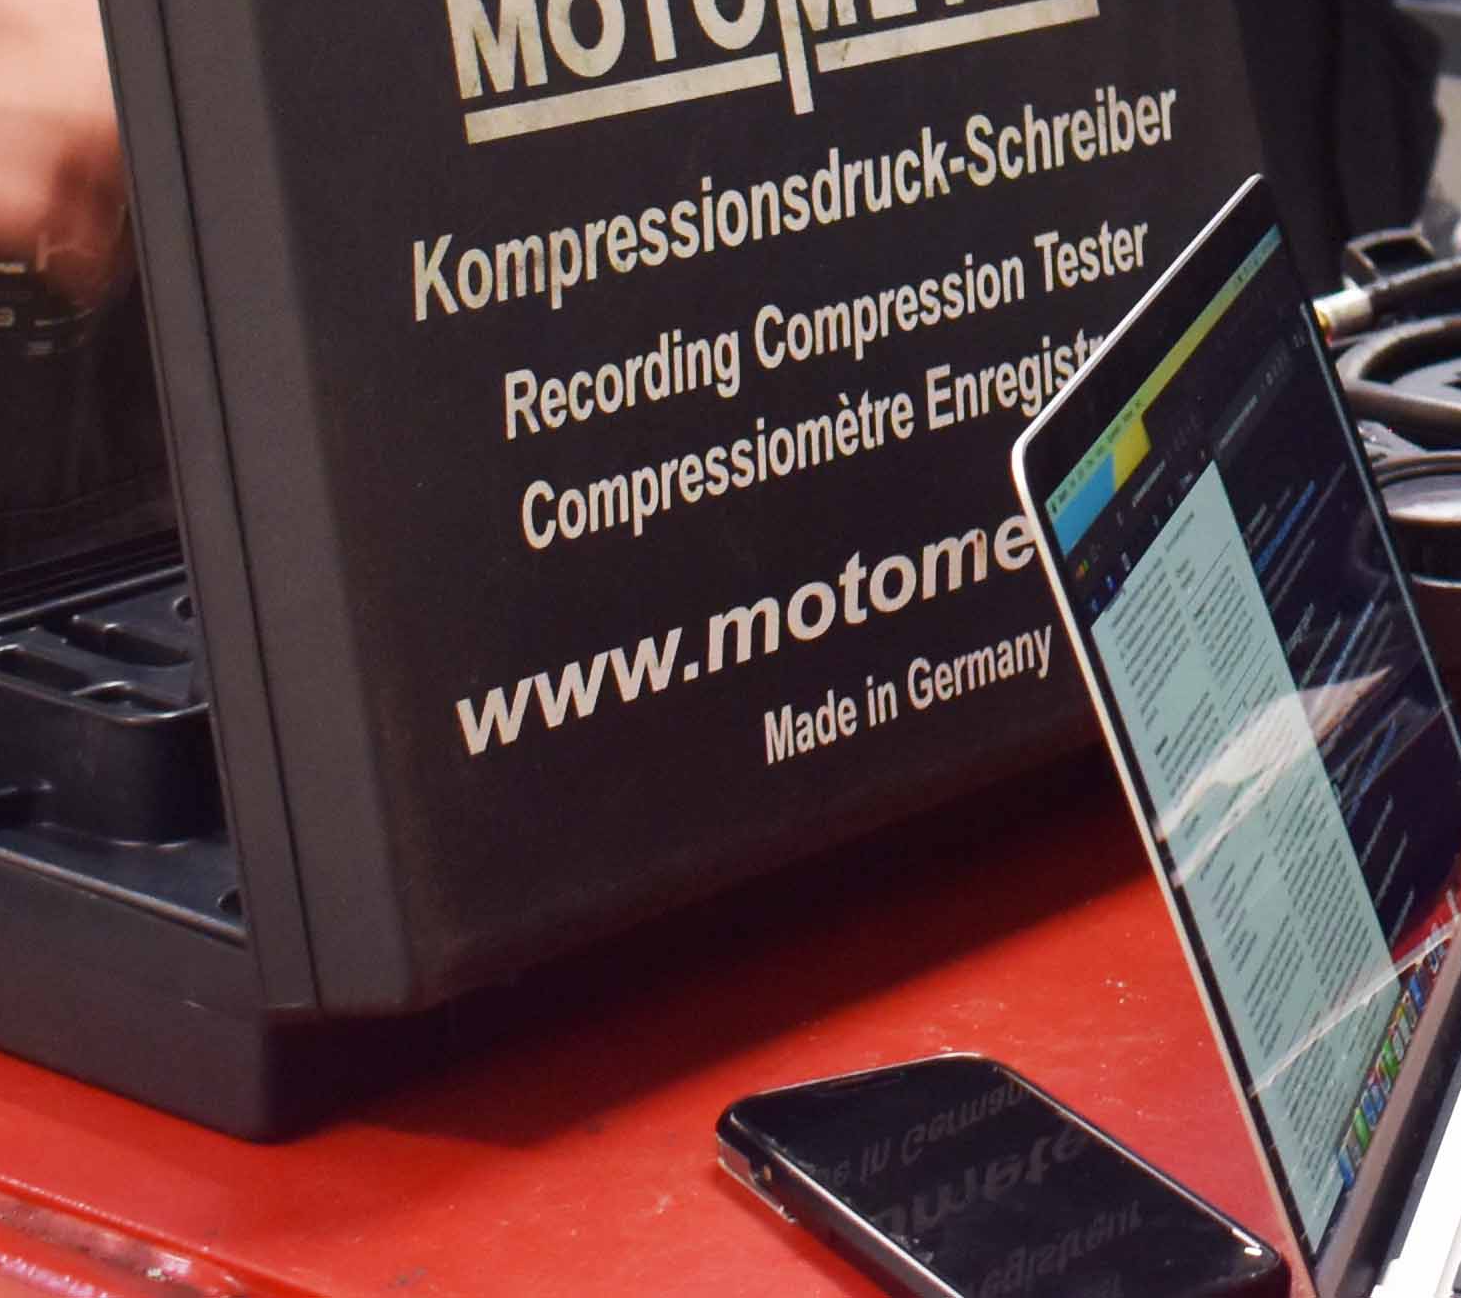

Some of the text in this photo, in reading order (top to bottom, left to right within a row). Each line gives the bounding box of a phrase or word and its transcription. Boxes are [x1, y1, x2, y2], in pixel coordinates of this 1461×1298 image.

[412, 87, 1178, 322] Kompressionsdruck-Schreiber
[504, 219, 1150, 440] Recording Compression Tester
[521, 390, 915, 550] Compressiomètre
[764, 621, 1053, 766] Made in Germany
